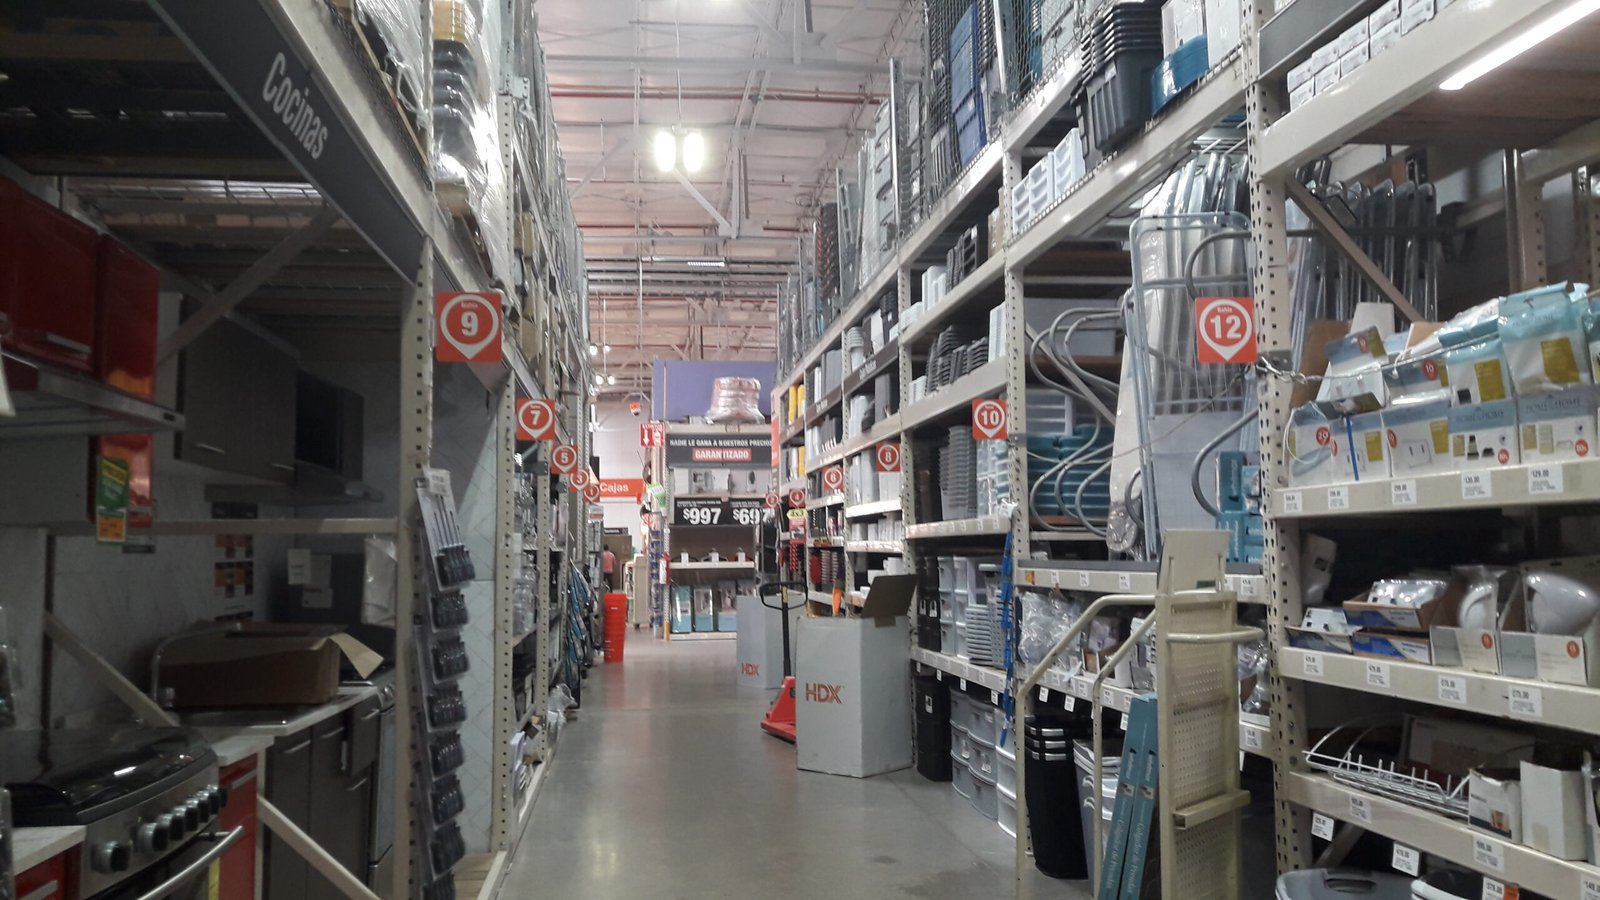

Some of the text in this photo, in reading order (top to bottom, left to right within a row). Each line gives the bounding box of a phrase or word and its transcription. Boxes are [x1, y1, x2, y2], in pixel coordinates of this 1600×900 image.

[262, 52, 328, 159] Cocinas
[461, 311, 478, 336] 9
[1210, 315, 1242, 339] 12
[530, 410, 541, 425] 7
[981, 411, 999, 426] 10
[561, 452, 569, 464] 5
[695, 450, 749, 459] GARANTIZADO
[885, 451, 892, 462] 8
[576, 475, 583, 483] 3
[830, 471, 837, 482] 6
[600, 482, 629, 493] Cajas
[683, 508, 722, 525] $997
[741, 663, 759, 676] HDX
[805, 682, 842, 704] HDX
